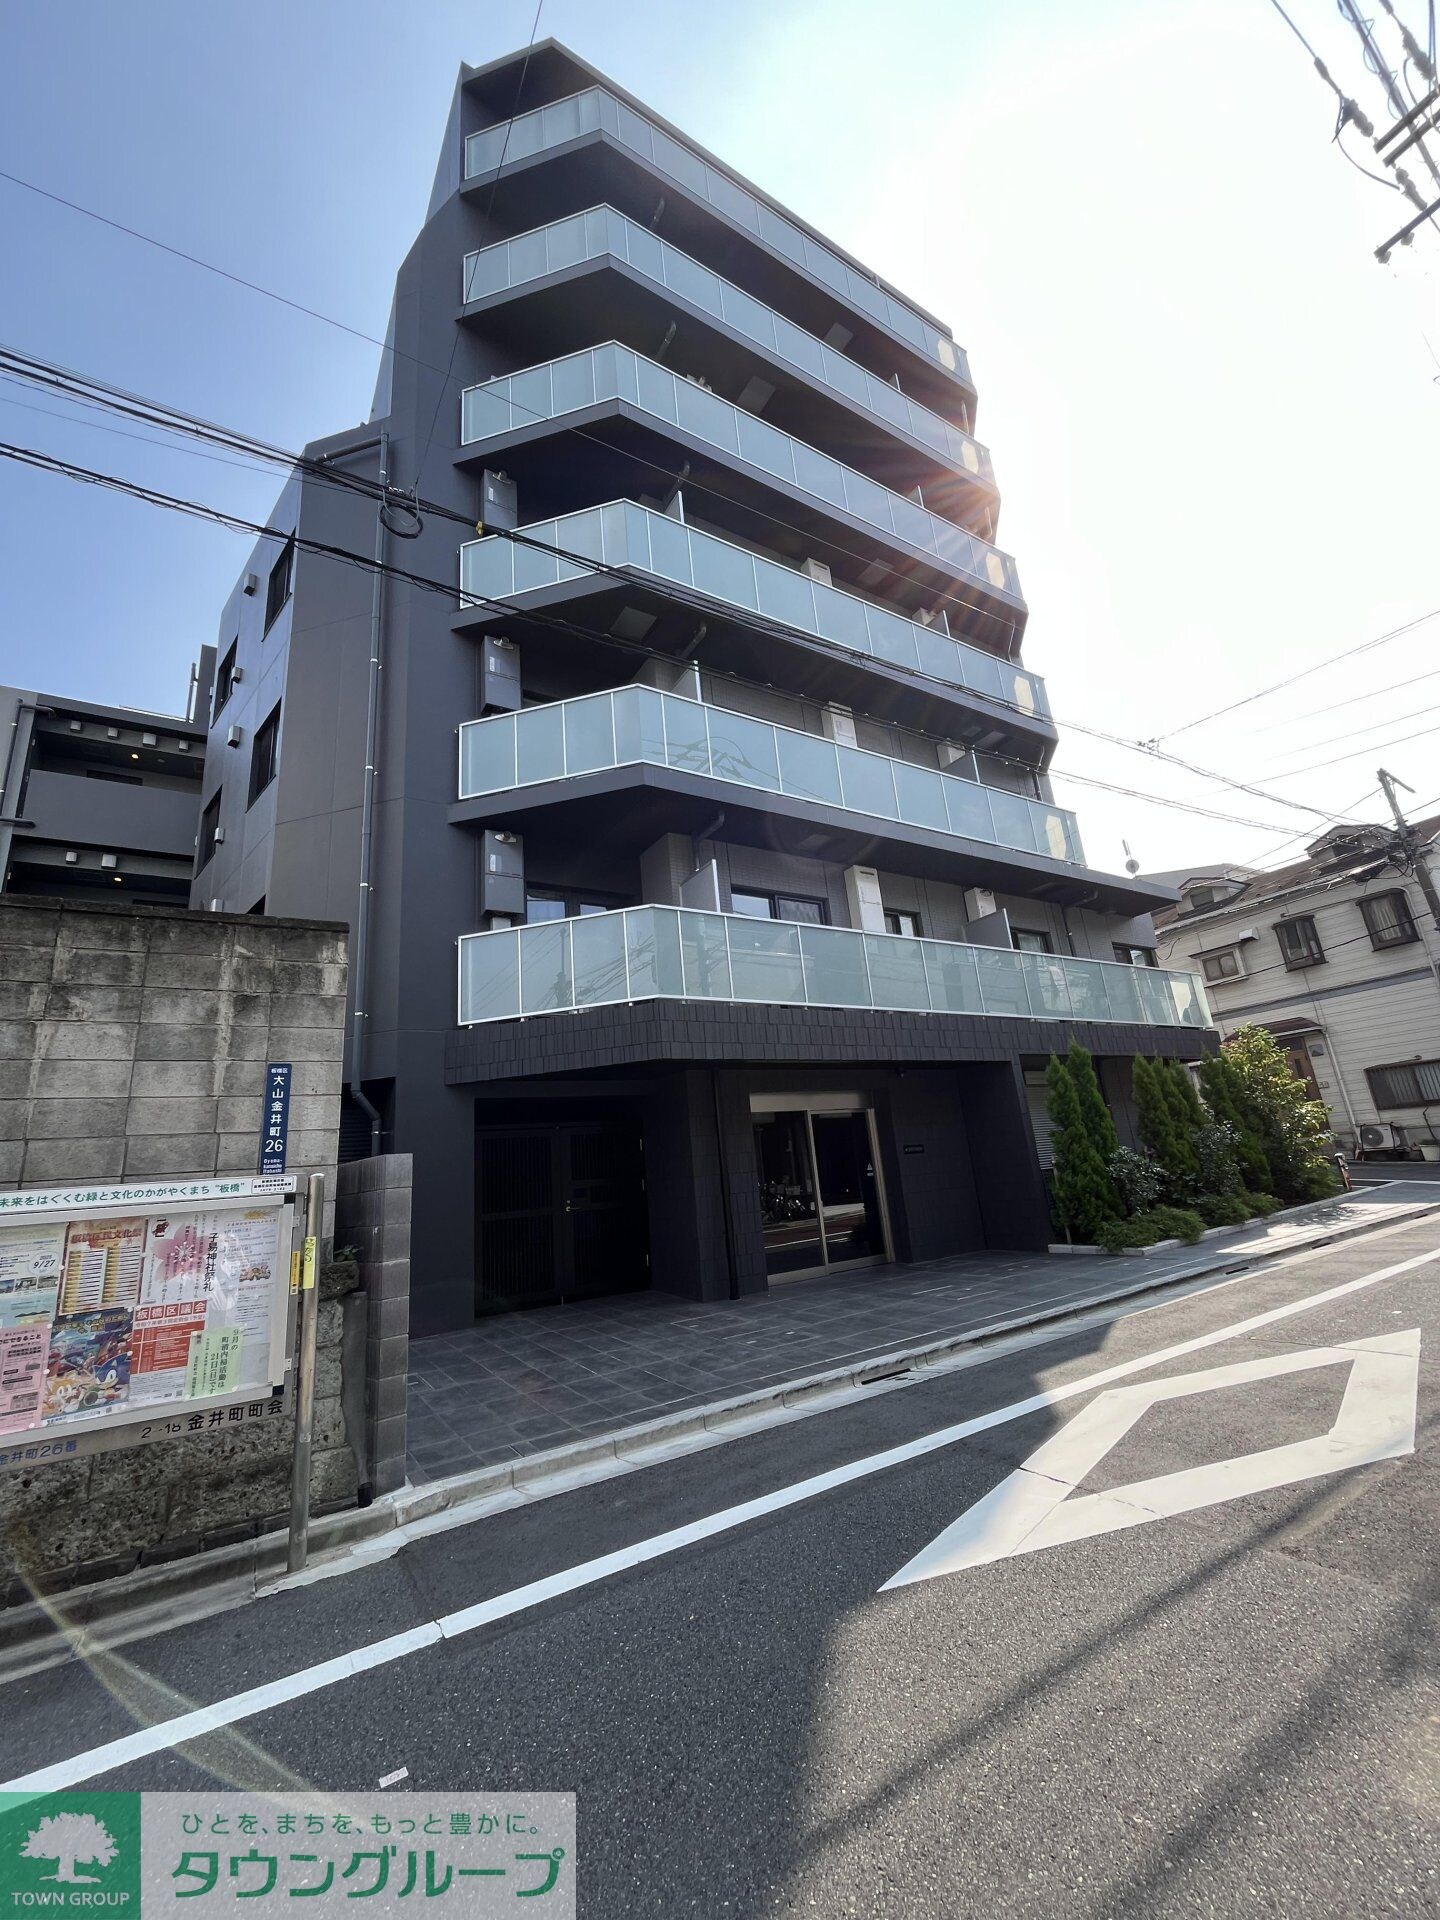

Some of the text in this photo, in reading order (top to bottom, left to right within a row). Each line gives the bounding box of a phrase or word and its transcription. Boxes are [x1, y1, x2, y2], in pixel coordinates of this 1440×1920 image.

[264, 1075, 285, 1153] 大山金井町 26
[33, 1259, 56, 1269] 9/27
[136, 1301, 206, 1320] 板橋区議会
[187, 1399, 284, 1431] 金井町町会
